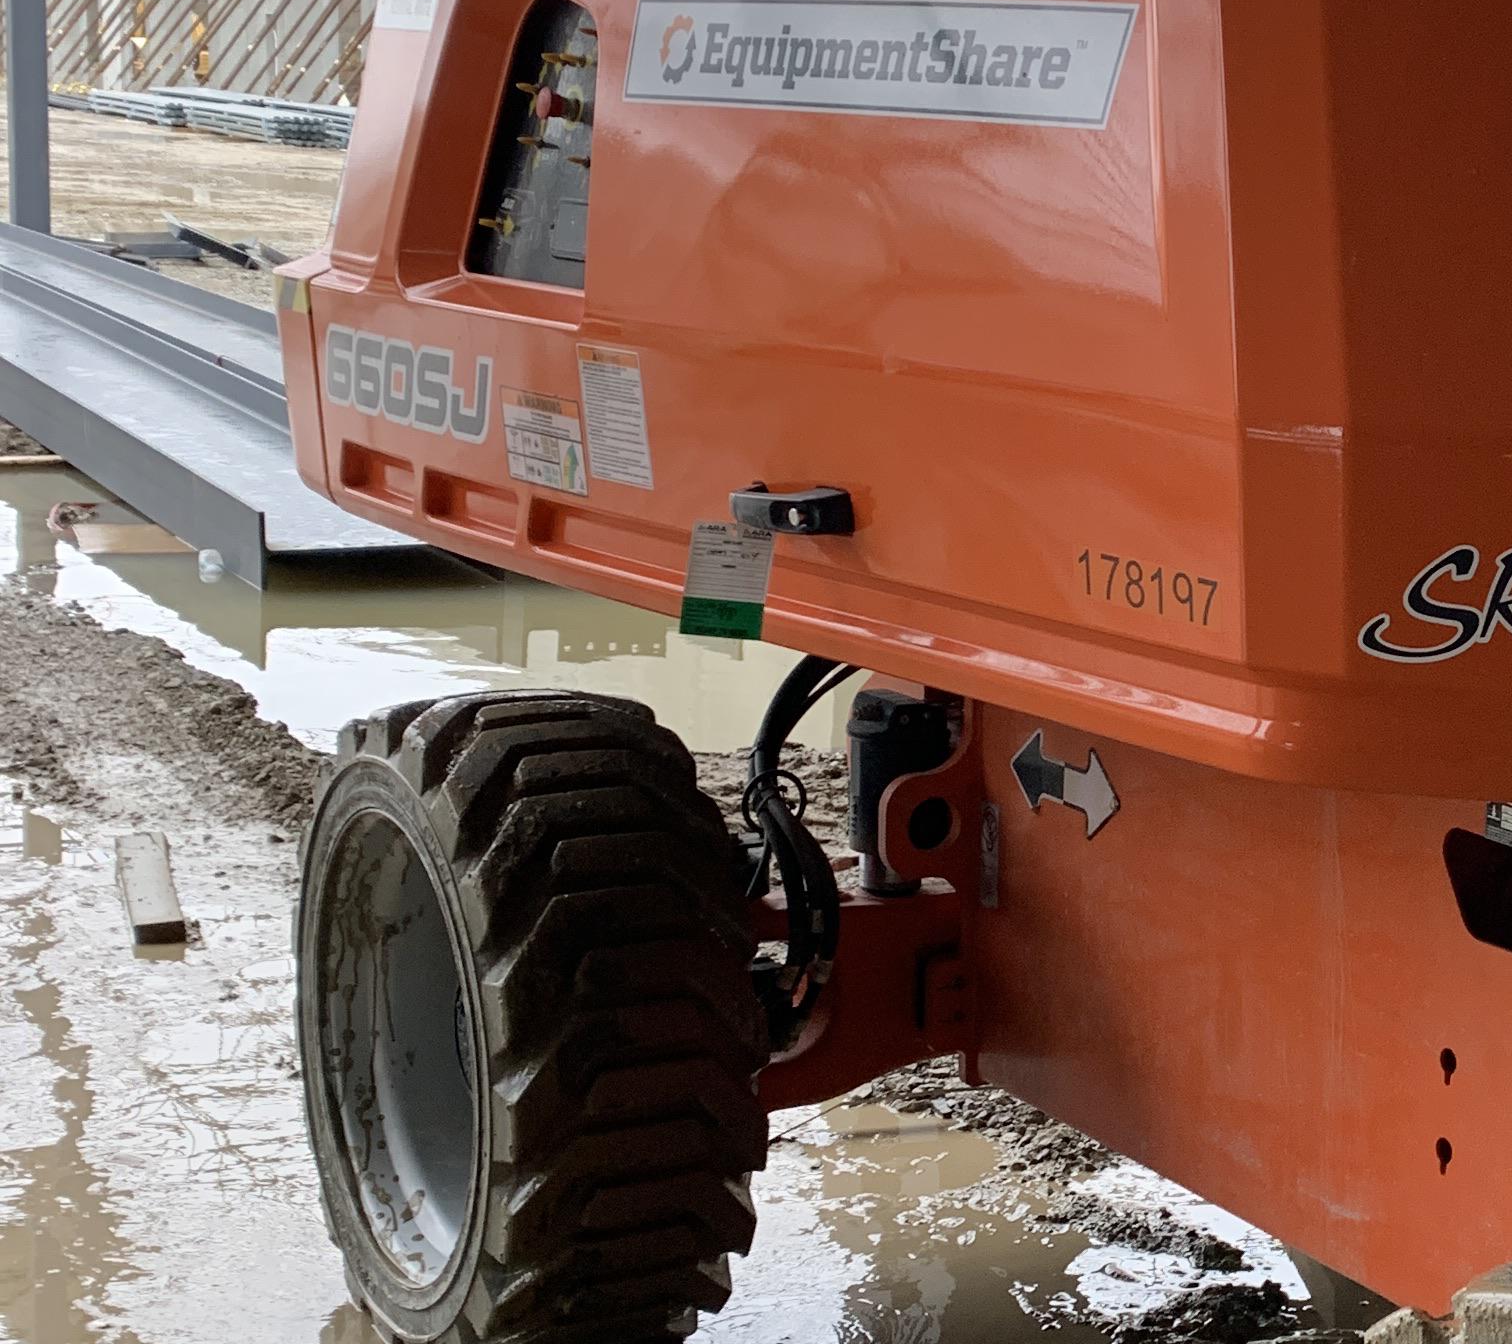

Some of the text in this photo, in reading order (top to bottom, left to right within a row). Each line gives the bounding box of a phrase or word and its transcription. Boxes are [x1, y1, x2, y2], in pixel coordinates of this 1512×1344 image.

[699, 22, 1072, 91] EquipmentShare
[326, 324, 492, 443] 660SJ
[1078, 548, 1218, 626] 178197
